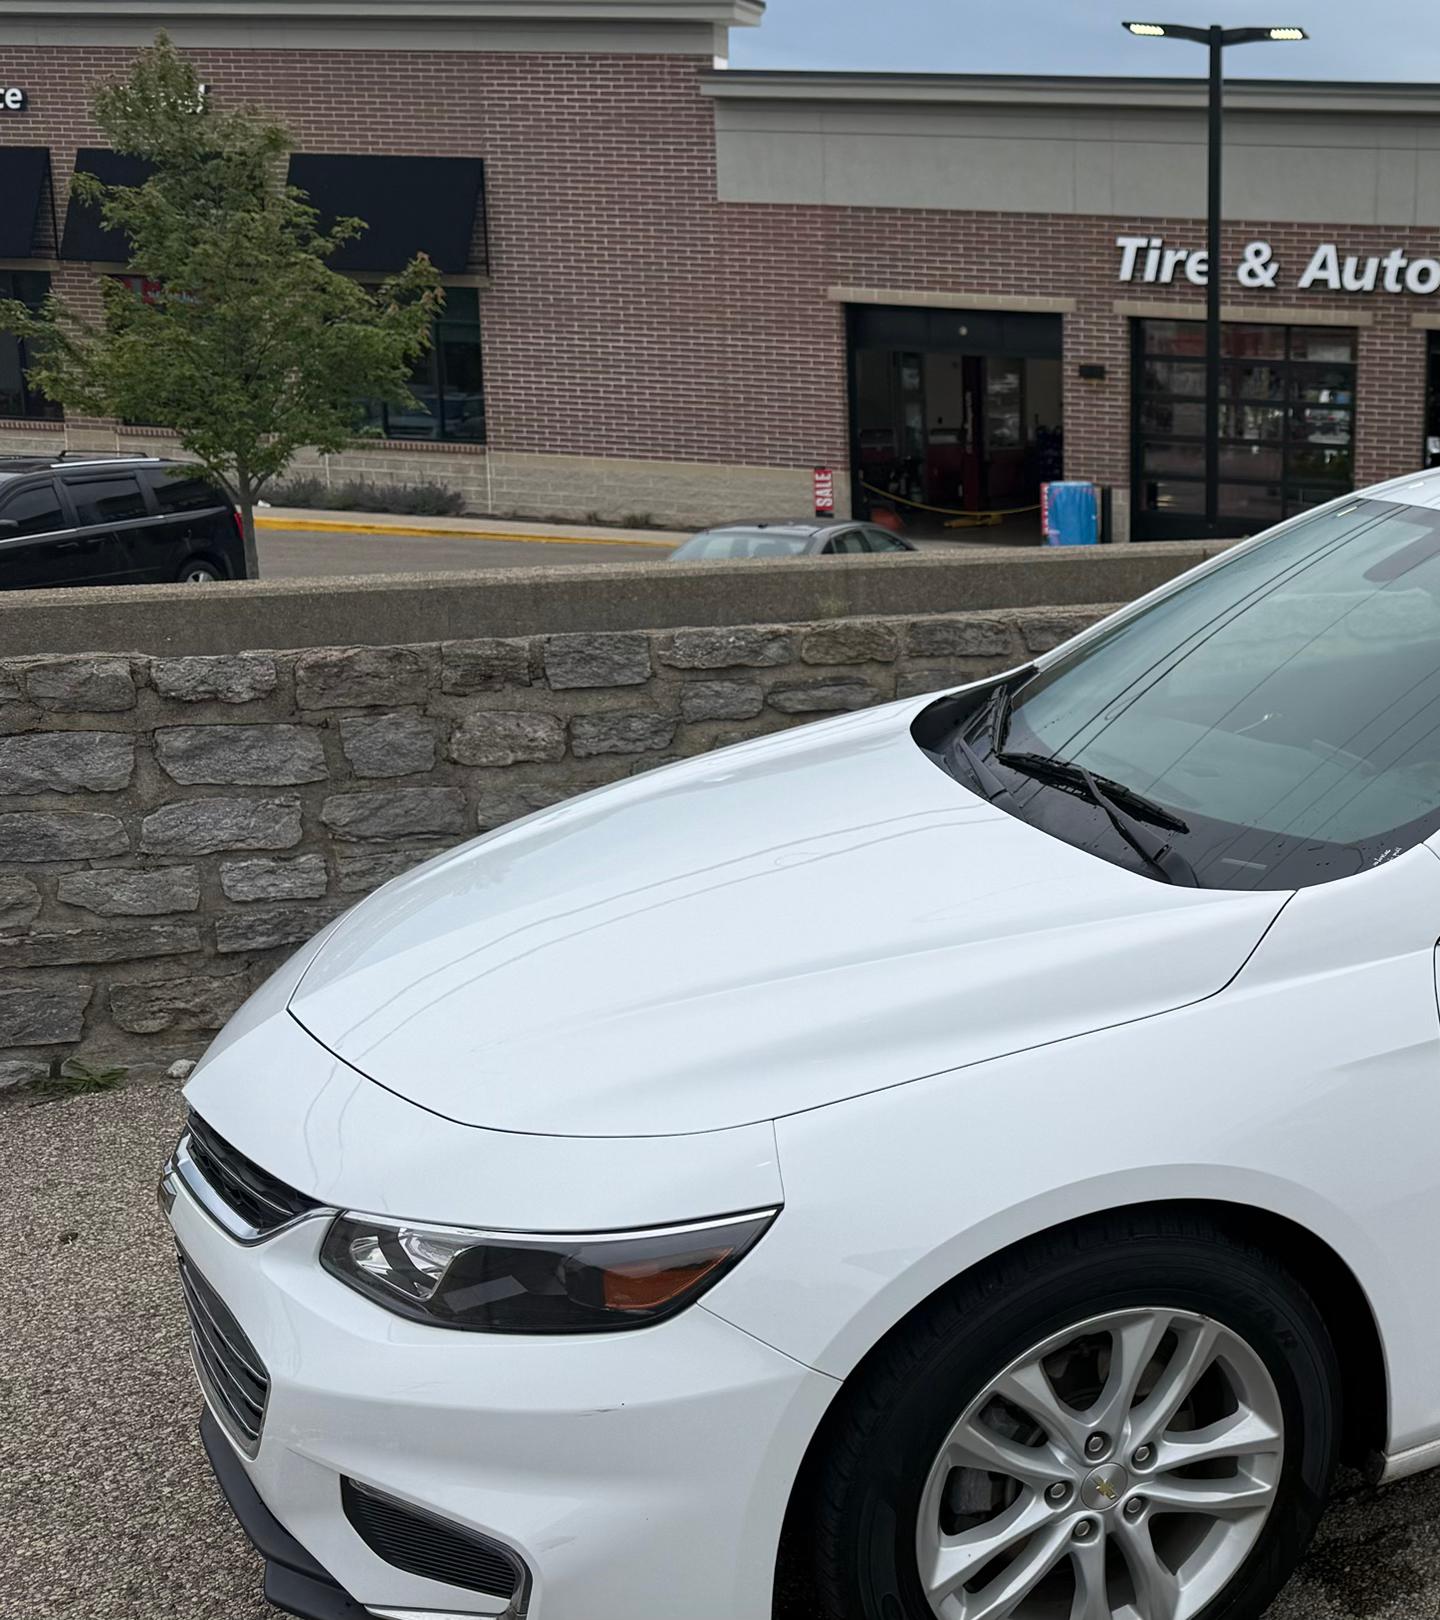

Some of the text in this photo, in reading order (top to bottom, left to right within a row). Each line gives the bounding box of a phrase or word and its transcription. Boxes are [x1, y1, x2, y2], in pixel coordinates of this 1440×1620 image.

[1116, 237, 1208, 285] Tire
[1237, 241, 1280, 288] &
[815, 473, 832, 506] SALE
